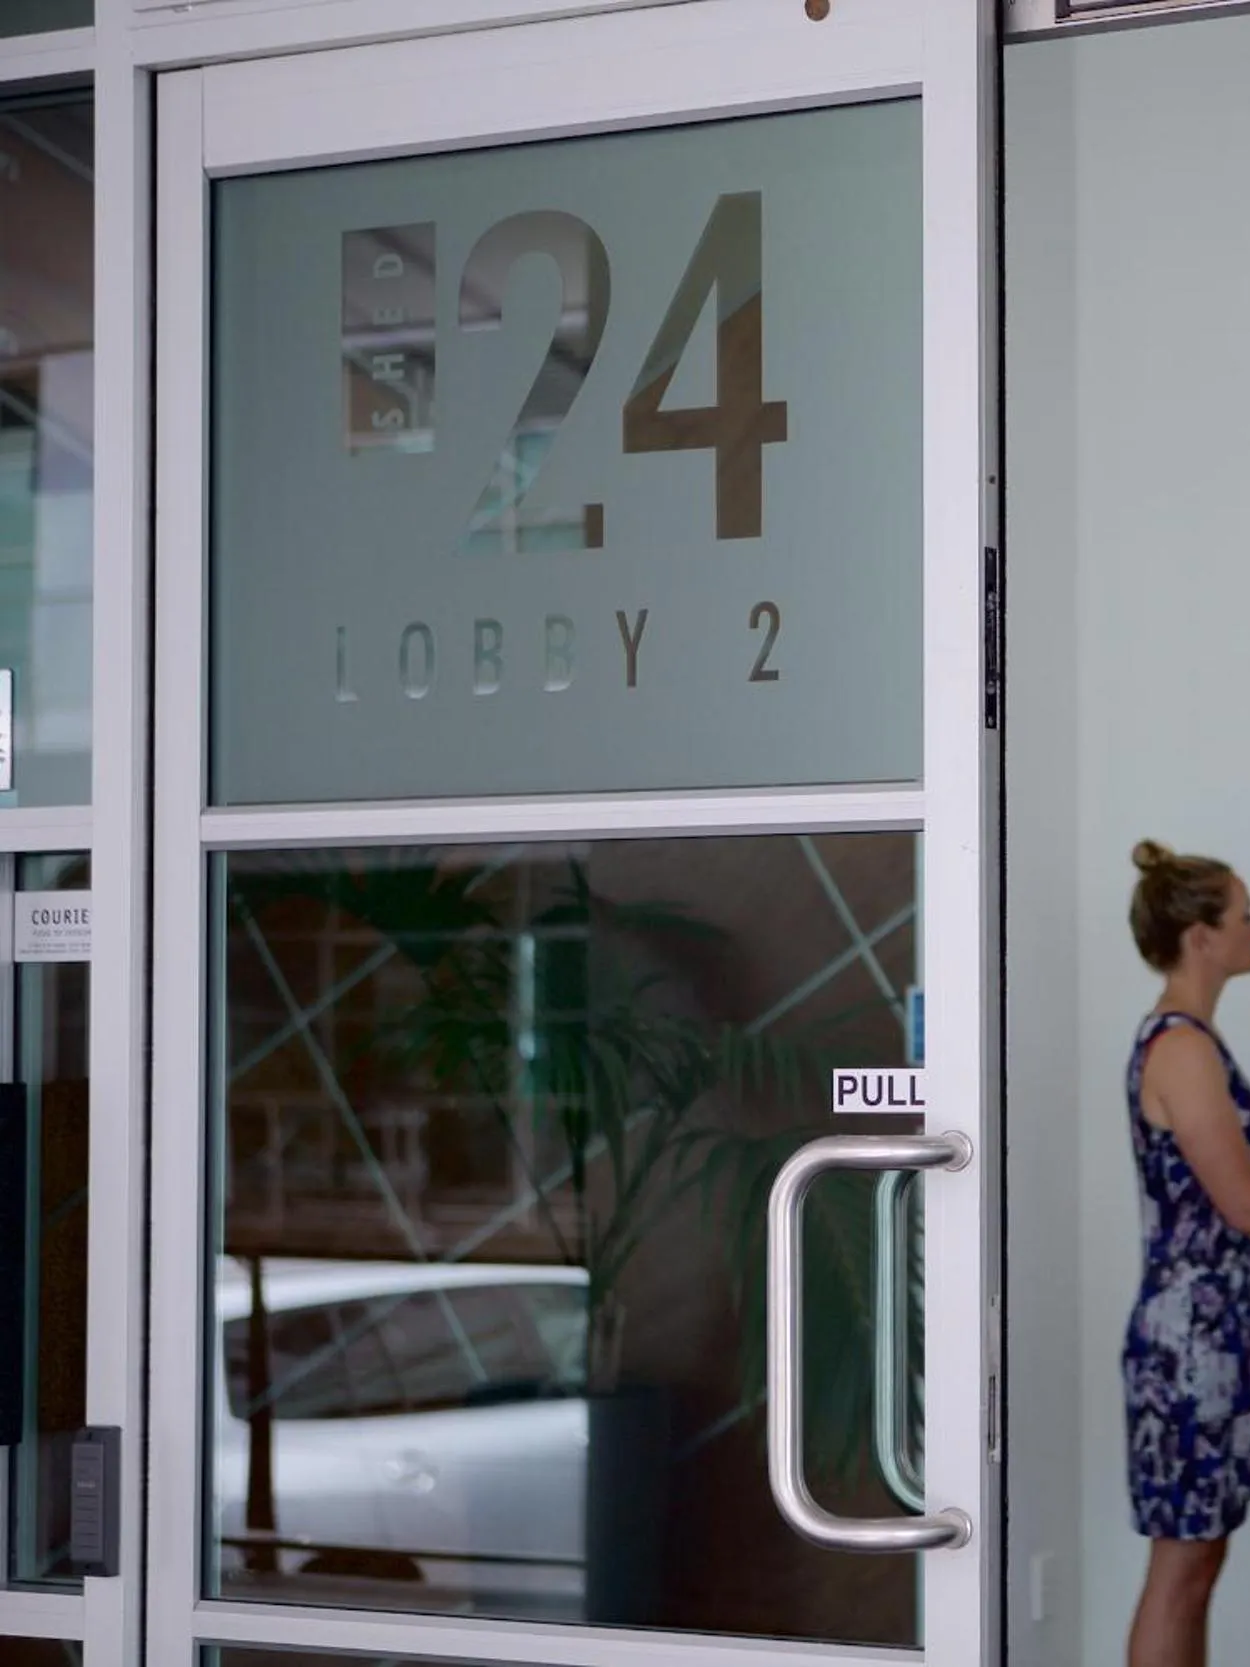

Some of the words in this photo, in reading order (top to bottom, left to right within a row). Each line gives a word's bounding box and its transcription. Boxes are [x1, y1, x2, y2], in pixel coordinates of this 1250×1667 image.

[371, 253, 405, 428] SHED
[456, 191, 787, 555] 24
[334, 608, 649, 702] LOBBY
[748, 601, 780, 682] 2
[31, 908, 89, 925] COURIE
[838, 1075, 925, 1106] PULL
